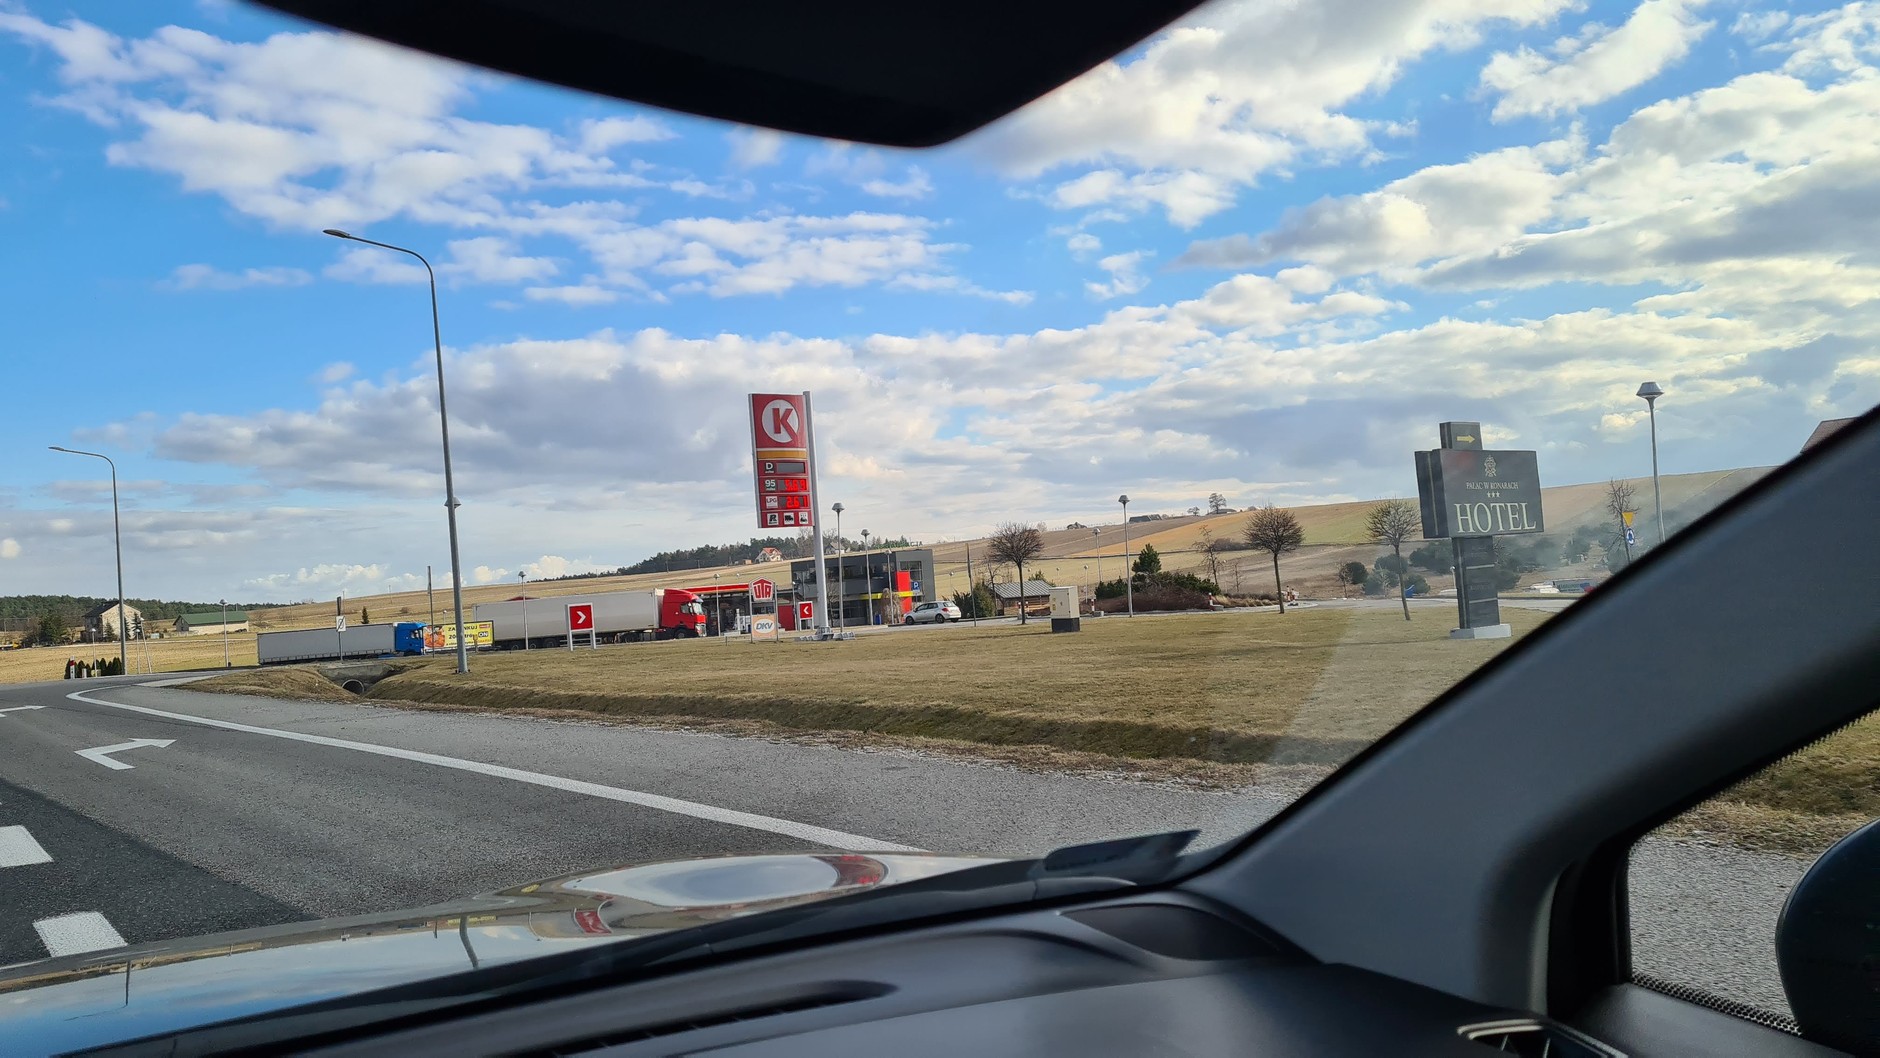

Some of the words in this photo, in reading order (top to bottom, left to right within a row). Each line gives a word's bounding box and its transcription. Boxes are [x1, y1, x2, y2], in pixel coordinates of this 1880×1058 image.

[772, 408, 797, 440] K
[765, 462, 773, 470] D
[765, 479, 776, 488] 95
[1454, 502, 1537, 533] HOTEL
[753, 579, 772, 598] UTA
[756, 622, 773, 630] DKV
